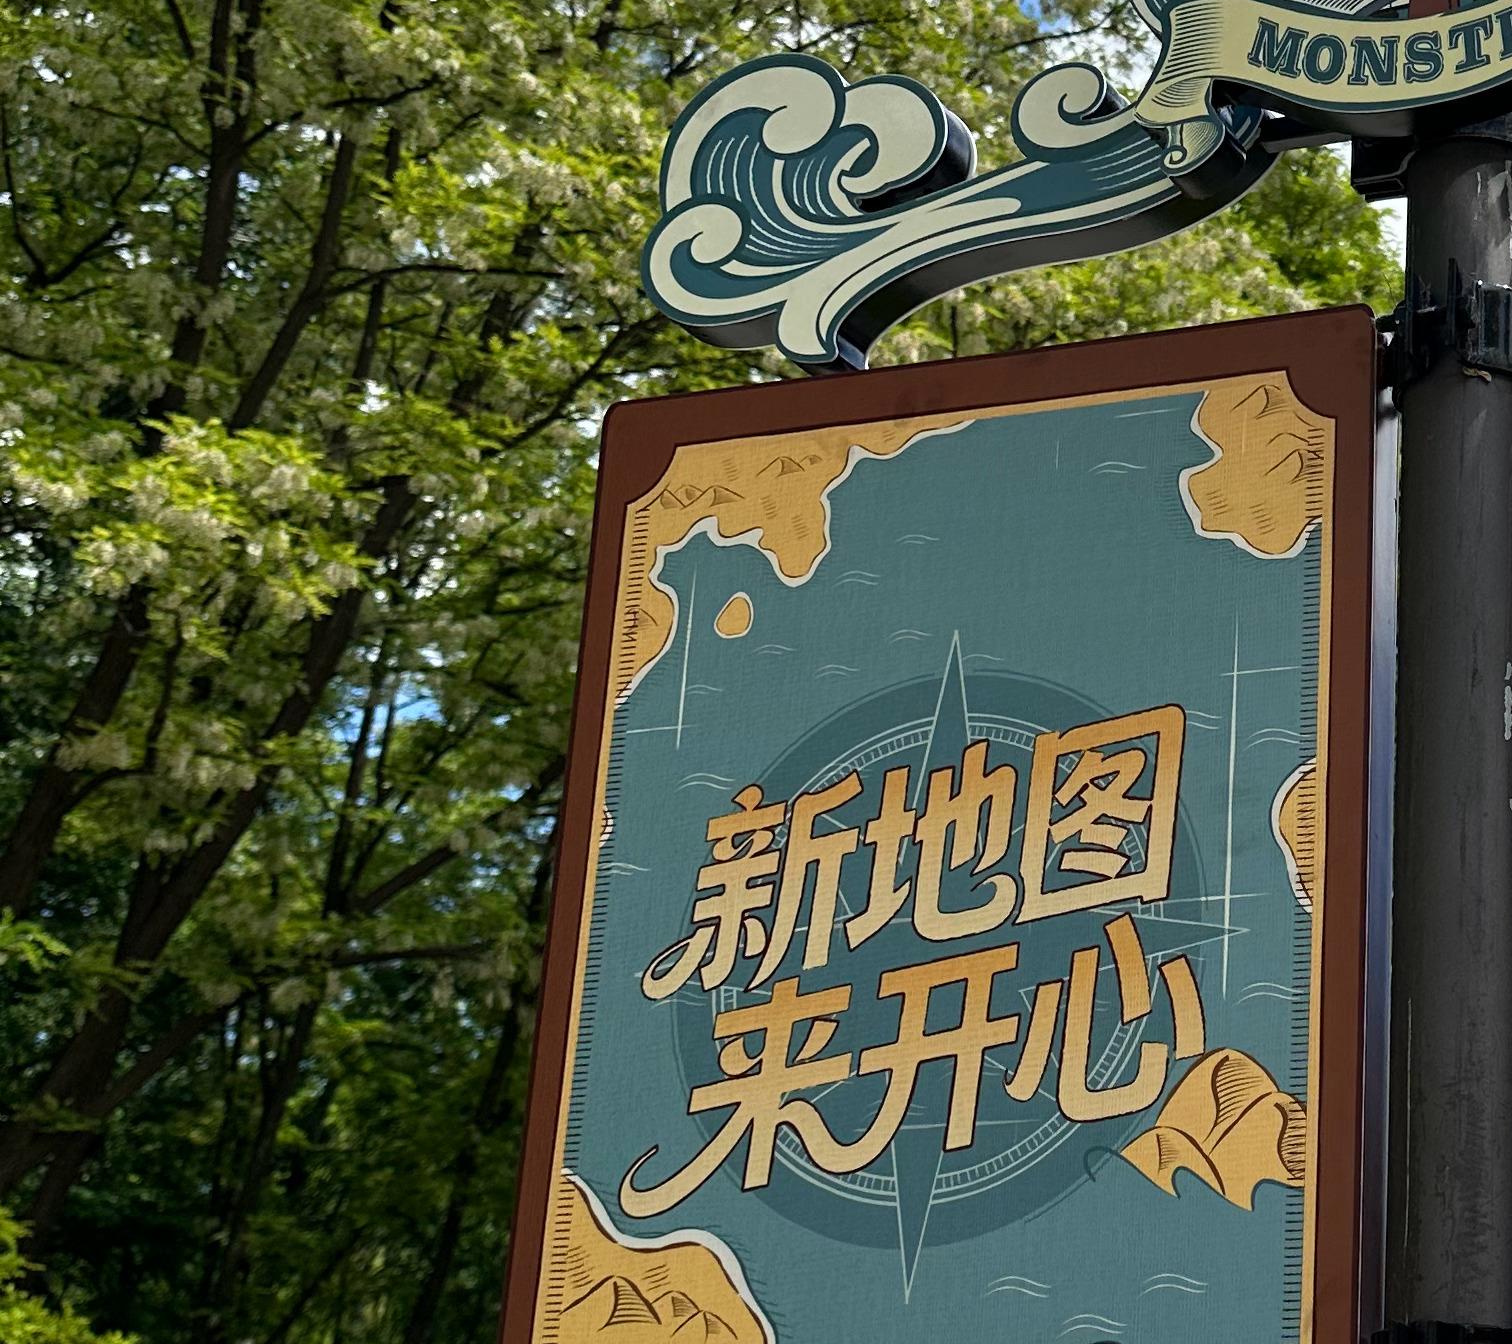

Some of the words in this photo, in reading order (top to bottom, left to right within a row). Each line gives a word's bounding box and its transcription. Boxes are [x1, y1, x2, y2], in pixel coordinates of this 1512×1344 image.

[640, 703, 1187, 1000] 新地图
[618, 913, 1206, 1219] 来开心
